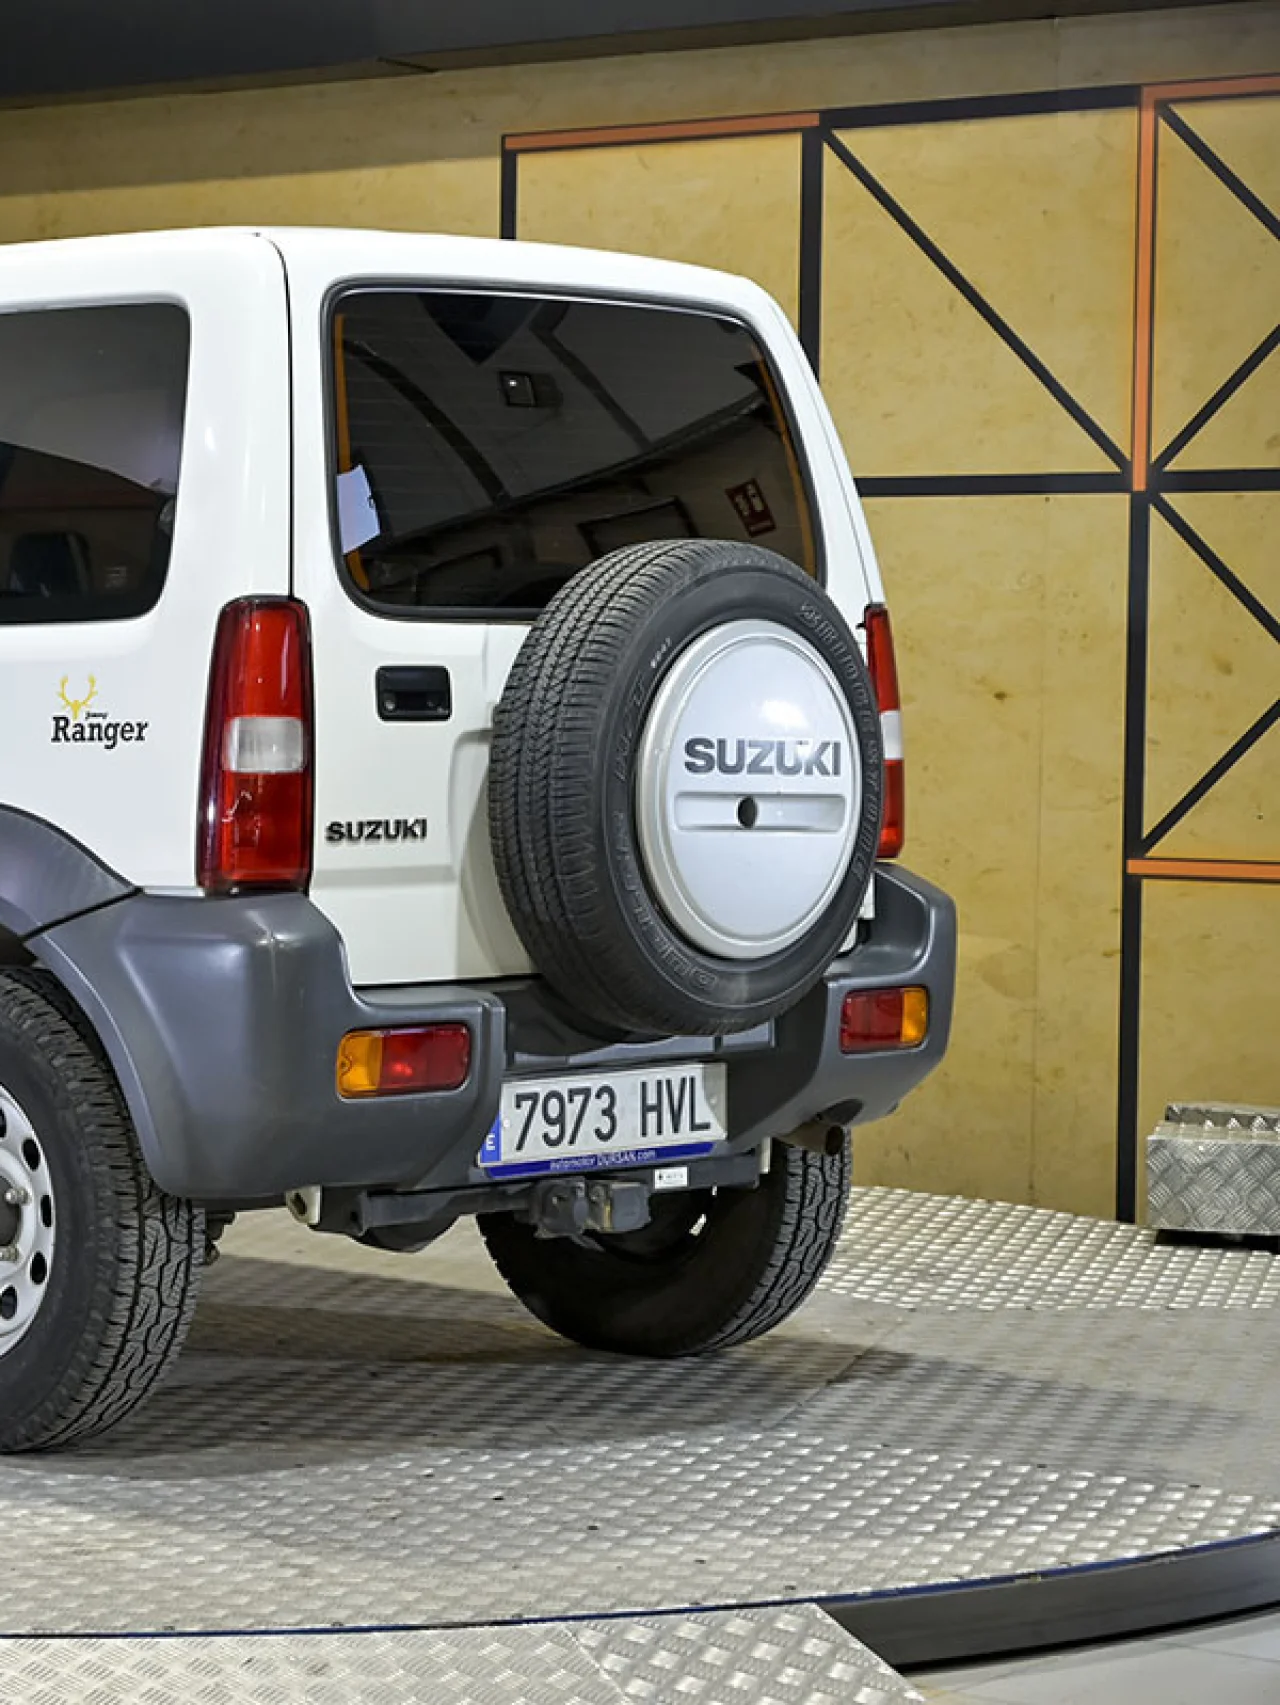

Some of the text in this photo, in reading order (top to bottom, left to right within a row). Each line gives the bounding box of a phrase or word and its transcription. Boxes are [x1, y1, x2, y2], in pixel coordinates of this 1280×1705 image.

[51, 716, 149, 750] Ranger
[684, 738, 841, 776] SUZUKI
[325, 818, 427, 843] SUZUKI
[515, 1076, 711, 1151] 7973 HVL
